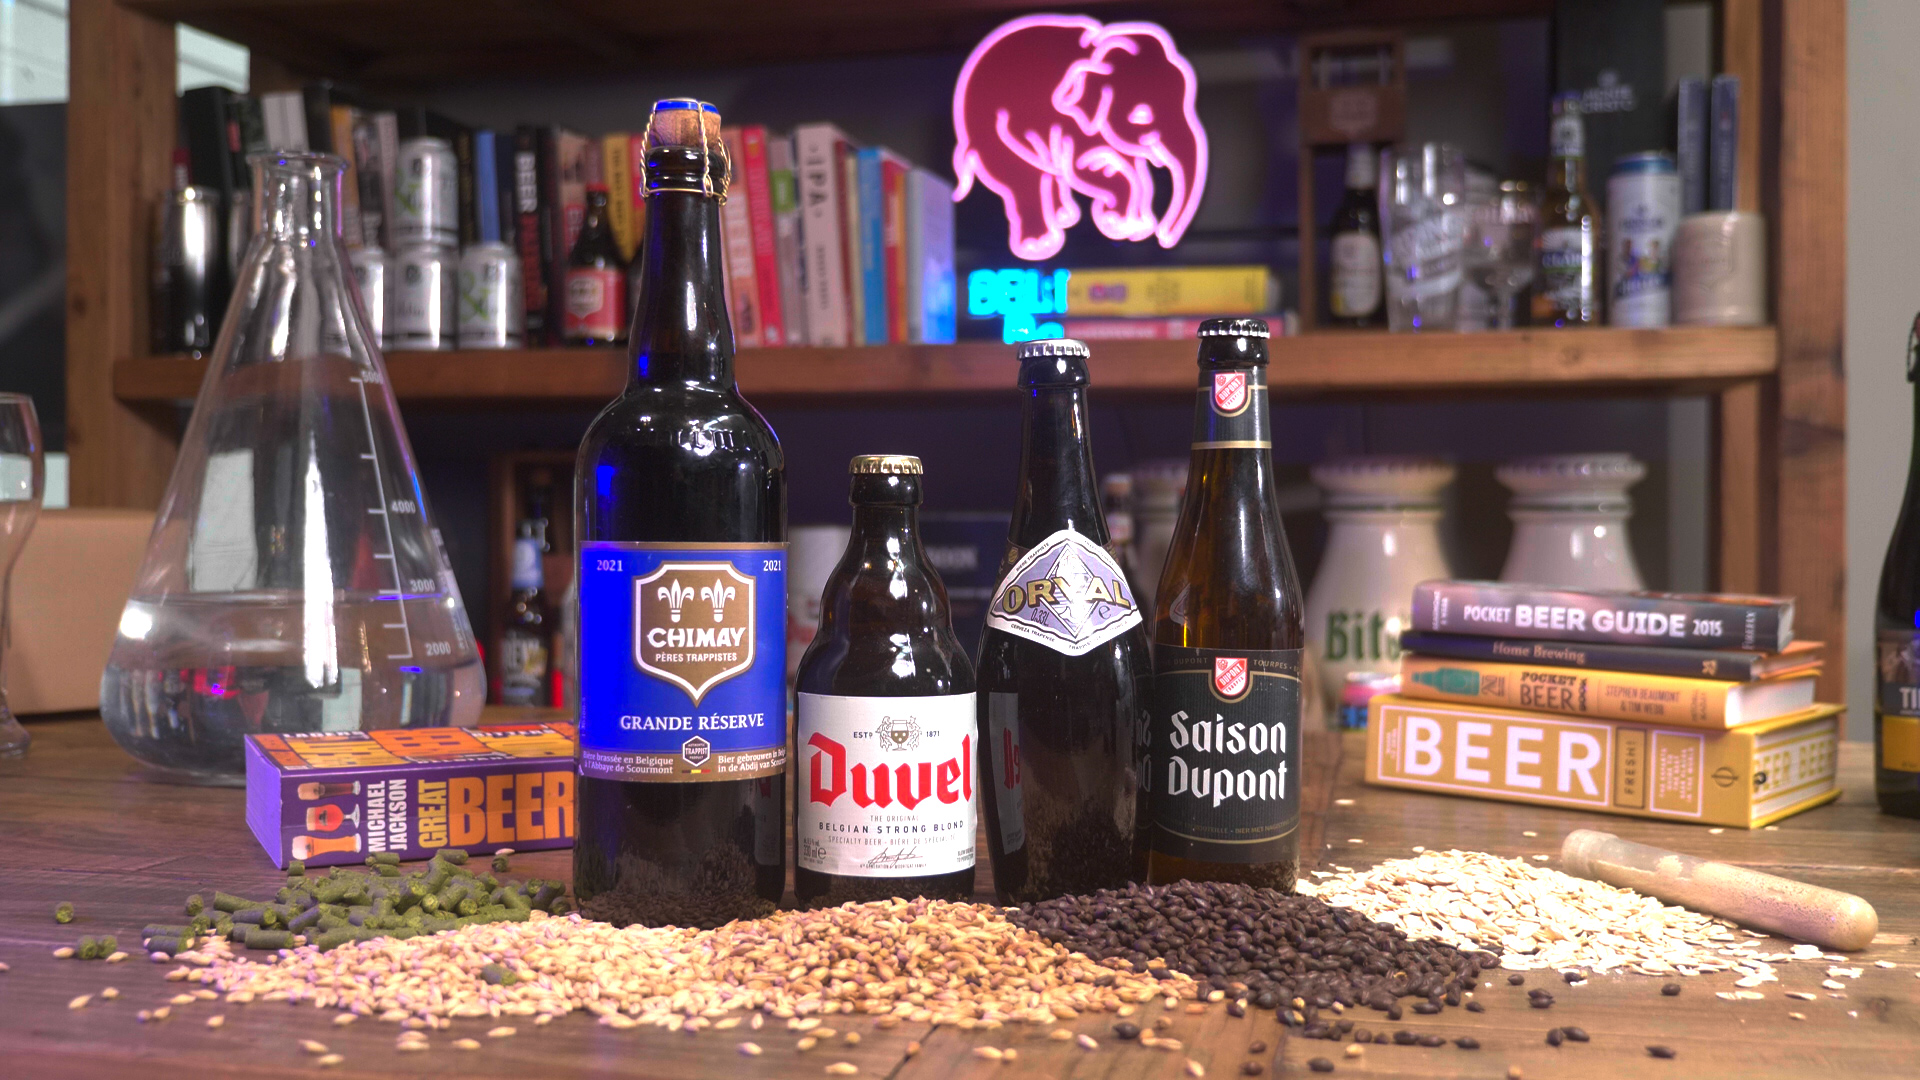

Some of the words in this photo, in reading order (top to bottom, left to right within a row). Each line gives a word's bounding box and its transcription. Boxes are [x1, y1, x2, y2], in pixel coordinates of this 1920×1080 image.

[516, 152, 537, 213] BEER
[807, 156, 826, 206] IPA
[362, 371, 384, 385] 5000
[1219, 378, 1241, 400] DUPONT
[391, 501, 416, 514] 4000
[596, 559, 624, 572] 2021
[763, 560, 781, 572] 2021
[410, 579, 435, 592] 3000
[1002, 576, 1132, 615] ORVAL
[1010, 623, 1030, 633] CERVEZA
[1463, 604, 1511, 623] POCKET
[1515, 604, 1586, 632] BEER
[1592, 609, 1686, 637] GUIDE
[1692, 619, 1723, 637] 2015
[647, 627, 746, 648] CHIMAY
[425, 642, 451, 655] 2000
[1492, 641, 1529, 657] Home
[1533, 645, 1586, 665] Brewing
[655, 651, 684, 662] PÈRES
[686, 652, 737, 663] TRAPPISTES
[1174, 657, 1208, 665] DUPONT
[1253, 659, 1288, 669] TOURPES
[1219, 663, 1243, 686] DUPONT
[1521, 671, 1577, 686] POCKET
[1520, 684, 1575, 711] BEER
[1605, 685, 1638, 698] STEPHEN
[1640, 688, 1679, 703] BEAUMONT
[1628, 701, 1641, 713] TIM
[1644, 703, 1664, 716] WEBB
[620, 715, 693, 730] GRANDE
[698, 712, 765, 730] RÉSERVE
[926, 730, 940, 738] 1871
[1169, 710, 1286, 755] Saison
[685, 747, 708, 755] TRAPPIST
[718, 755, 735, 764] Bier
[737, 753, 772, 764] gebrouwen
[1404, 716, 1601, 796] BEER
[596, 752, 621, 763] brassée
[635, 755, 674, 766] Belgique
[718, 764, 726, 772] in
[728, 764, 738, 772] de
[739, 761, 758, 771] Abdij
[759, 761, 770, 769] van
[615, 764, 625, 772] de
[626, 765, 674, 774] Scourmont
[808, 731, 972, 811] Duvel
[1624, 740, 1637, 795] FRESH!
[1168, 755, 1288, 808] Dupont
[367, 780, 386, 853] MICHAEL
[388, 778, 407, 851] JACKSON
[418, 779, 448, 848] GREAT
[448, 770, 574, 847] BEER
[819, 822, 869, 834] BELGIAN
[877, 825, 927, 834] STRONG
[933, 820, 964, 832] BLOND
[828, 836, 862, 845] SPECIALTY
[865, 838, 882, 846] BEER
